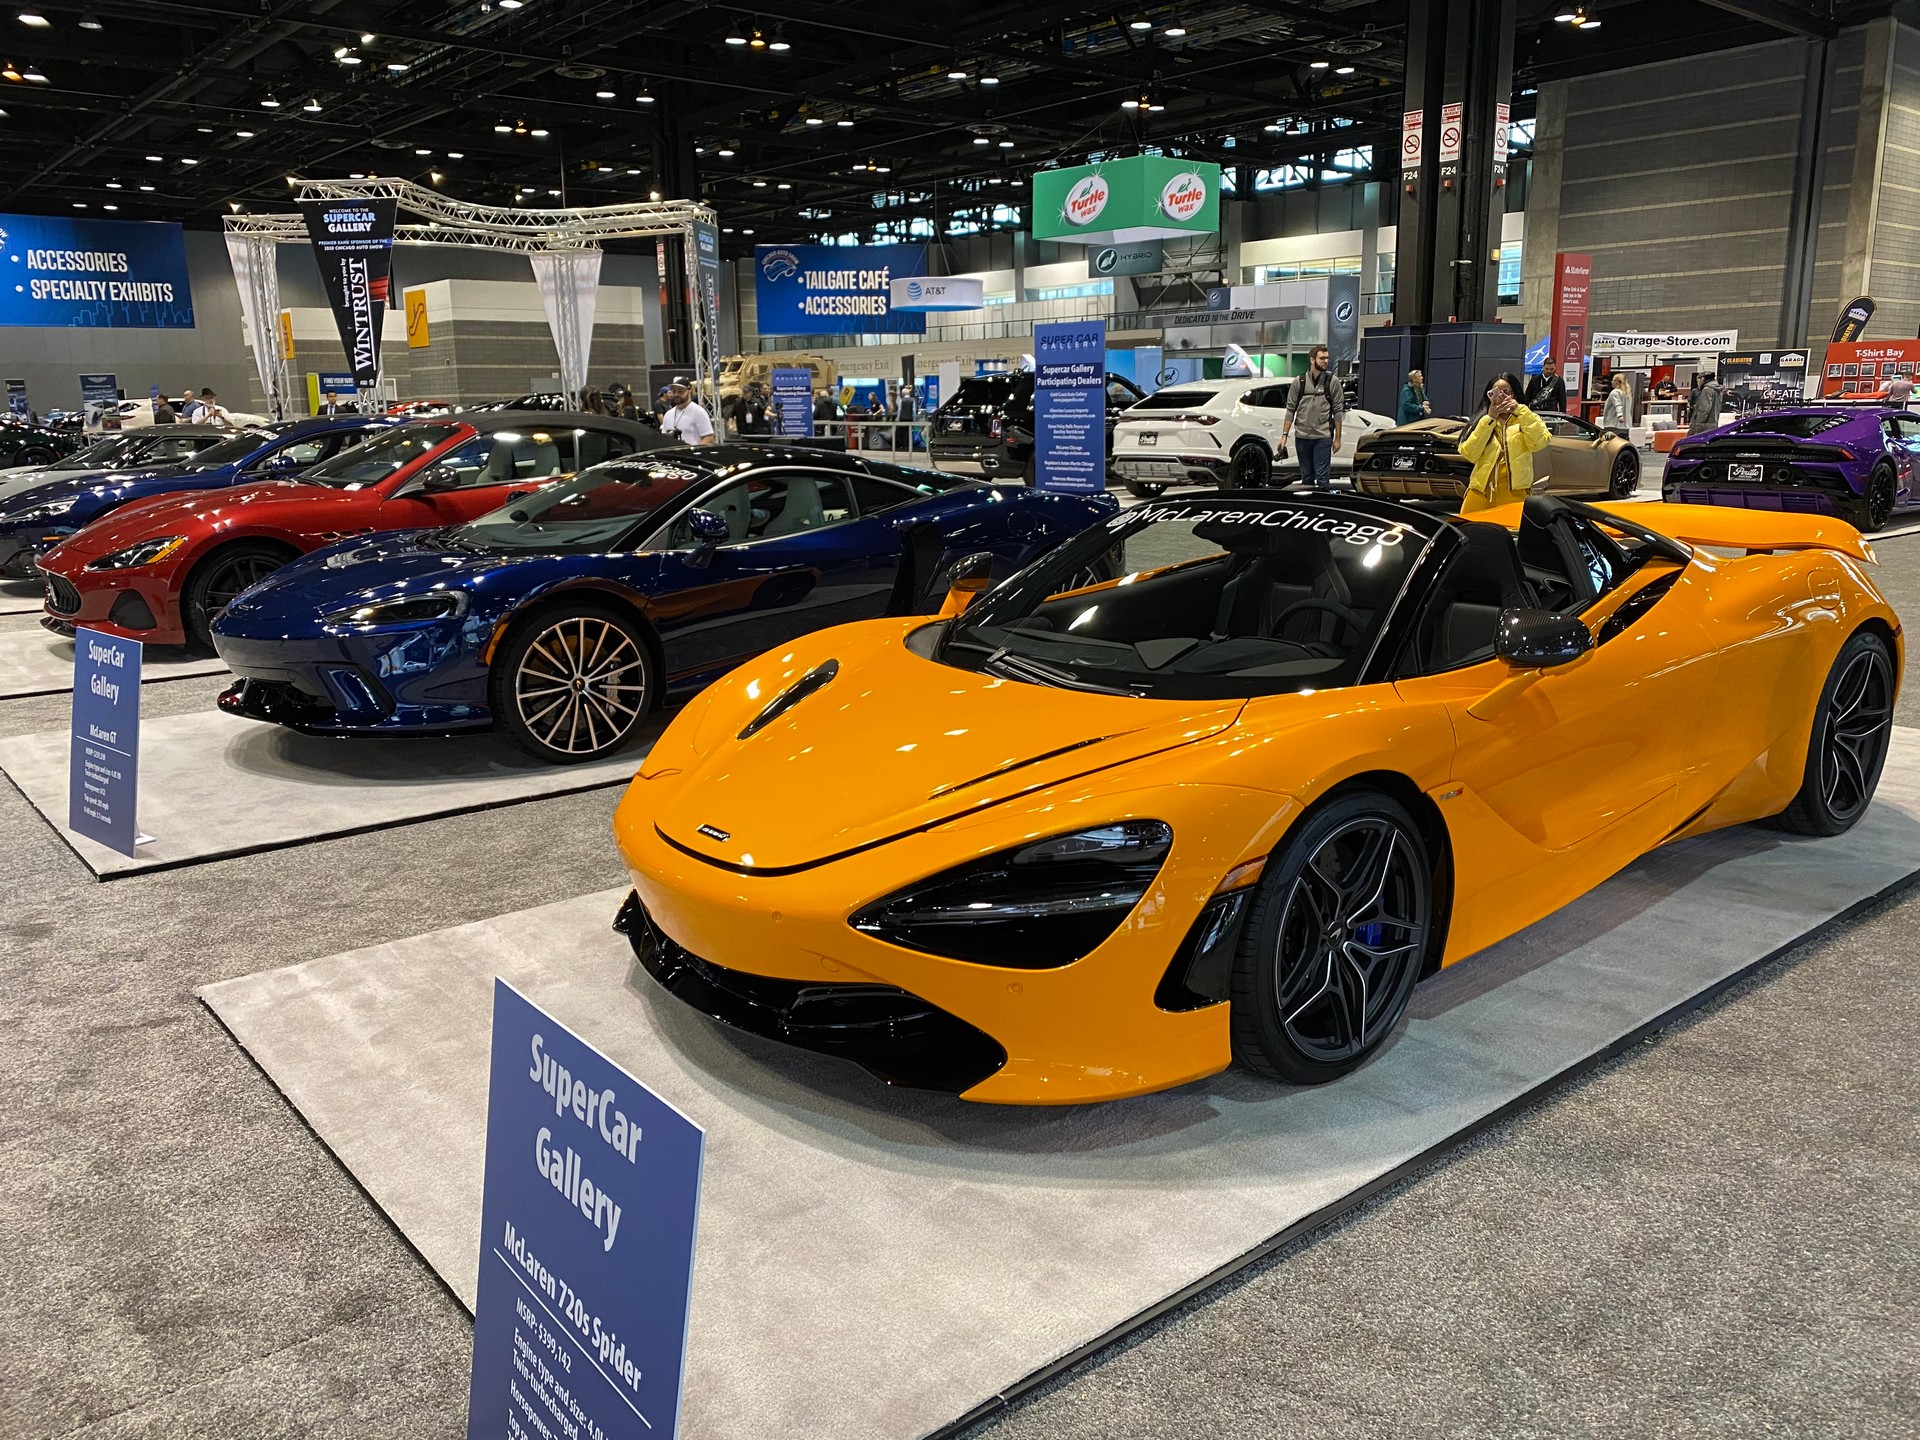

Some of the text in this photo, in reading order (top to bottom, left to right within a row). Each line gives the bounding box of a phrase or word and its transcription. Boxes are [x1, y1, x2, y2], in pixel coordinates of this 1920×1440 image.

[1404, 171, 1418, 180] F24
[1441, 167, 1456, 175] F24
[1494, 165, 1504, 174] F24
[1071, 188, 1105, 213] Turtle
[1168, 188, 1203, 207] Turtle
[323, 212, 376, 223] SUPERCAR
[1081, 206, 1097, 218] wax
[1178, 204, 1194, 213] wax
[328, 223, 372, 233] GALLERY
[27, 250, 128, 272] ACCESSORIES
[1121, 251, 1152, 260] HYBRID
[804, 266, 889, 290] TAILGATE CAFÉ
[30, 279, 173, 303] SPECIALTY EXHIBITS
[925, 286, 946, 296] AT&T
[349, 257, 373, 371] WINTRUST
[805, 296, 886, 315] ACCESSORIES
[1174, 314, 1210, 325] DEDICATED
[1230, 311, 1256, 320] DRIVE
[1041, 333, 1099, 345] SUPER CAR
[1042, 341, 1097, 350] GALLERY
[1617, 335, 1730, 347] Garage-Store.com
[1856, 349, 1904, 358] T-Shirt Bay
[875, 359, 889, 370] Exit
[1043, 364, 1094, 375] Supercar Gallery
[1037, 376, 1102, 387] Participating Dealers
[1733, 466, 1760, 476] Perillo
[1106, 504, 1404, 546] @McLarenChicago
[88, 639, 125, 668] SuperCar
[91, 674, 119, 706] Gallery
[90, 724, 117, 744] McLaren GT
[529, 1033, 643, 1165] SuperCar
[534, 1127, 622, 1252] Gallery
[504, 1220, 642, 1392] McLaren 720s Spider
[516, 1297, 572, 1374] MSRP: $399,142
[514, 1327, 537, 1368] Engine
[538, 1358, 554, 1388] type
[554, 1381, 569, 1406] and
[569, 1399, 586, 1429] size:
[513, 1348, 578, 1440] Twin-turbocharged
[511, 1379, 552, 1440] Horsepower:
[509, 1408, 520, 1438] Top
